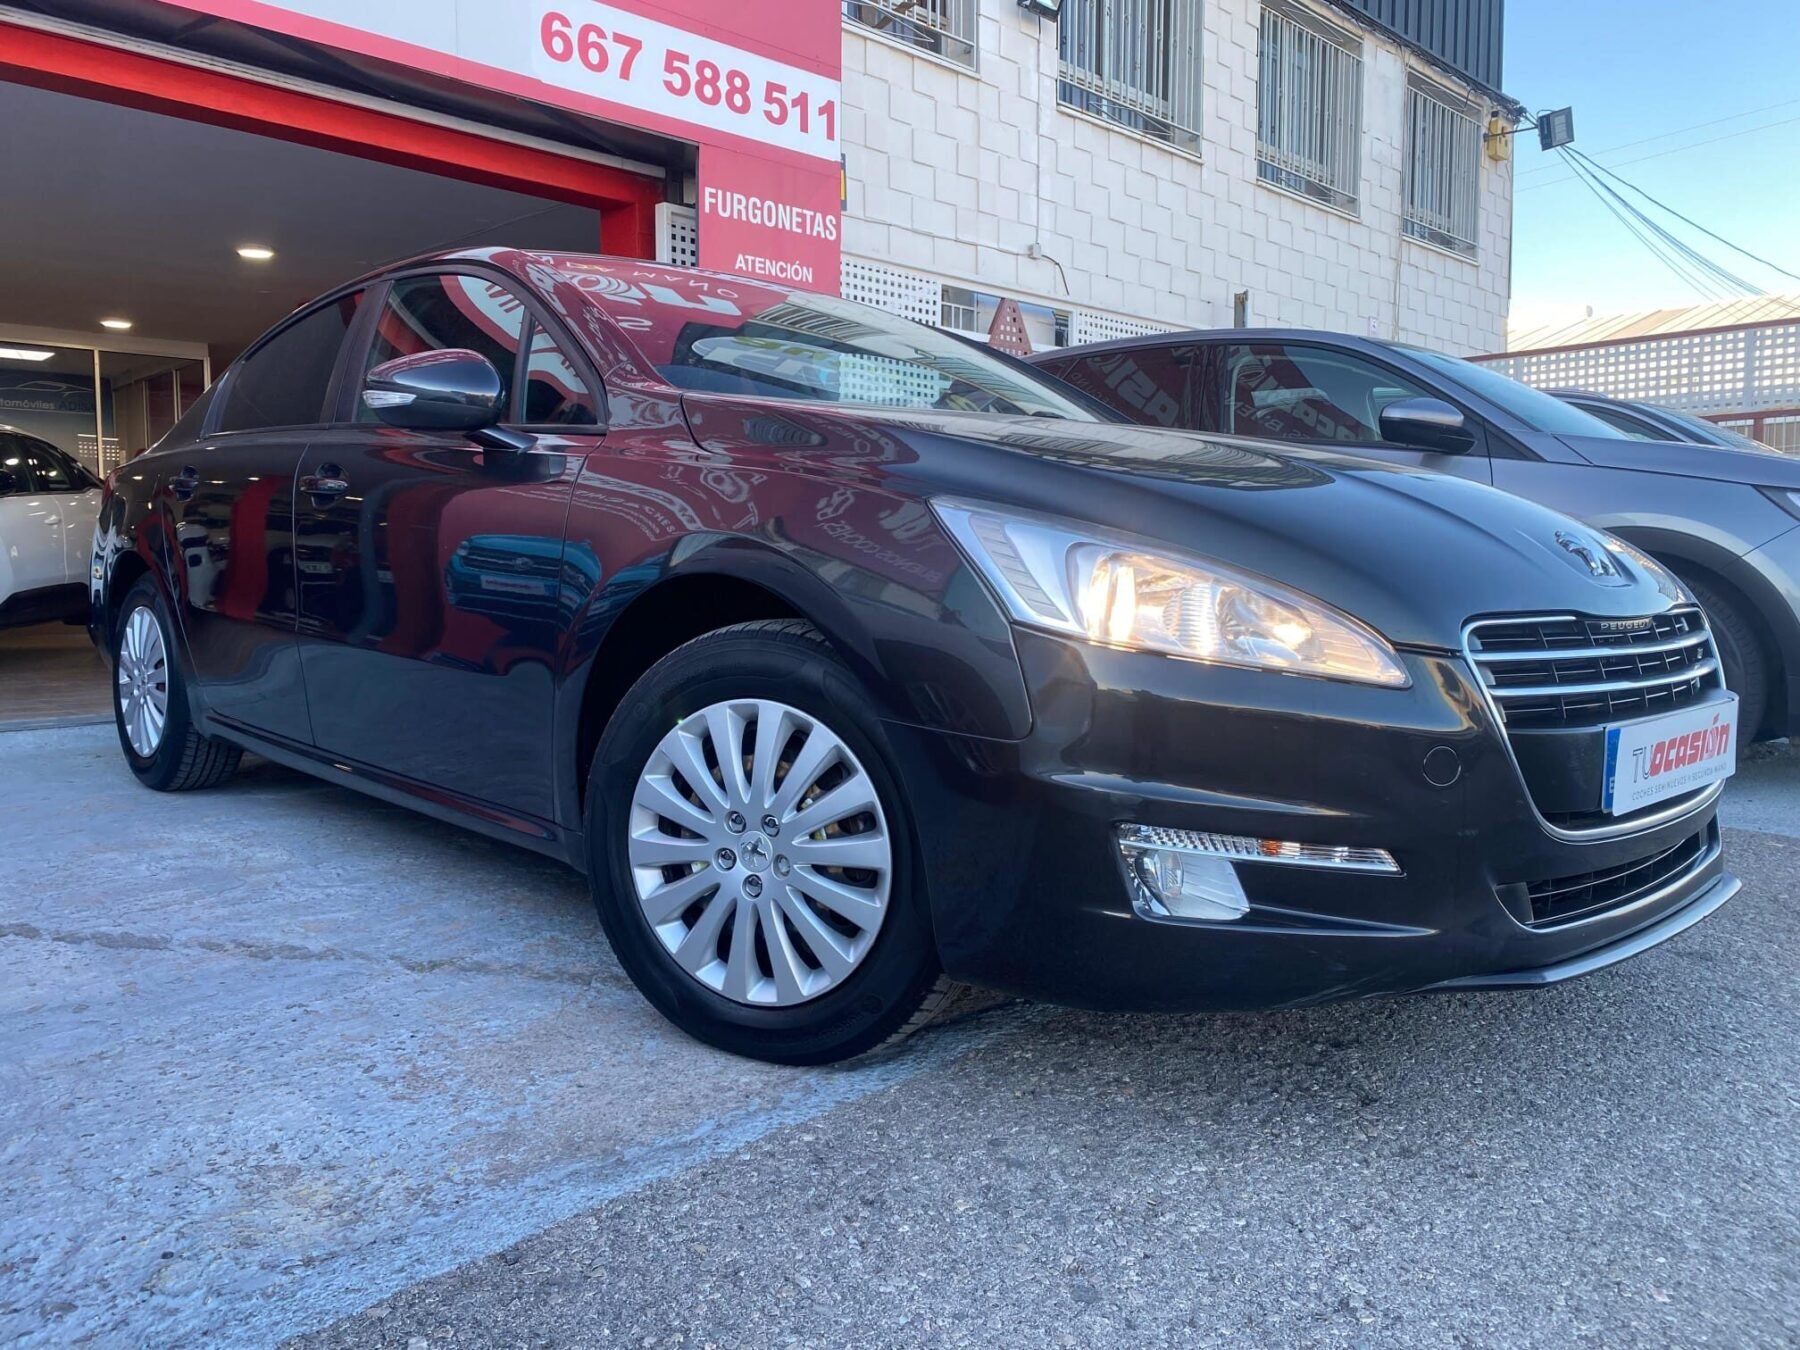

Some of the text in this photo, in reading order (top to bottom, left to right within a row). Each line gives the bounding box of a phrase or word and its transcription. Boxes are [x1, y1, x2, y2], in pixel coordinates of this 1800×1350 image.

[540, 11, 836, 141] 667 588 511
[704, 187, 837, 241] FURGONETAS
[734, 254, 813, 283] ATENCIÓN
